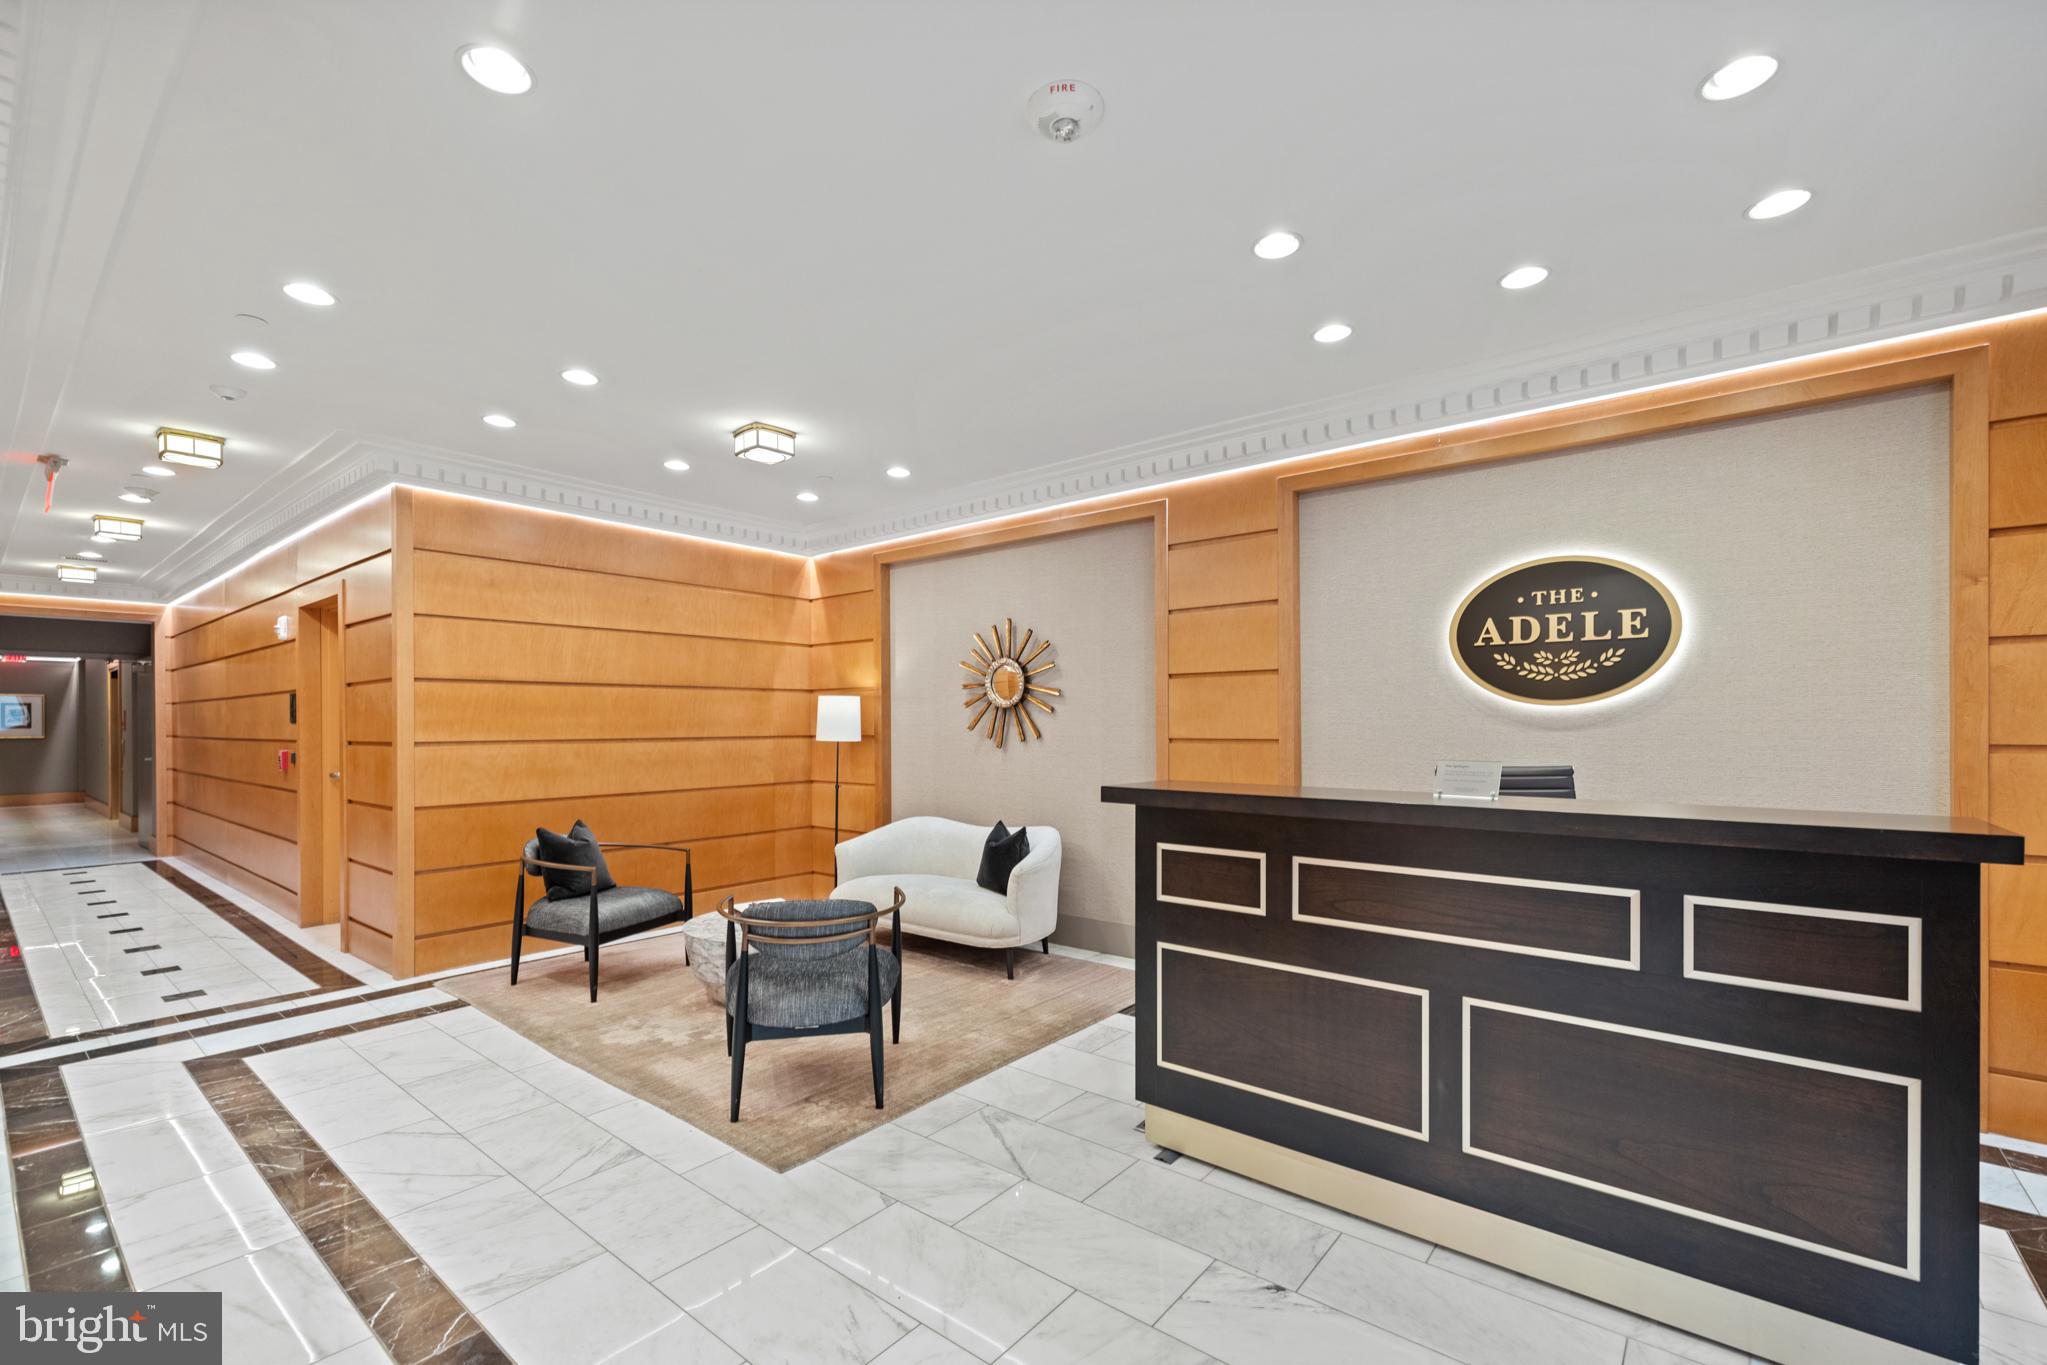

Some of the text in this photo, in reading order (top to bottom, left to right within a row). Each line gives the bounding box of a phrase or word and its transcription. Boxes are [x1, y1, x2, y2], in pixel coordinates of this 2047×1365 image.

[1049, 83, 1077, 95] FIRE
[1531, 587, 1585, 606] THE
[1473, 607, 1650, 647] ADELE
